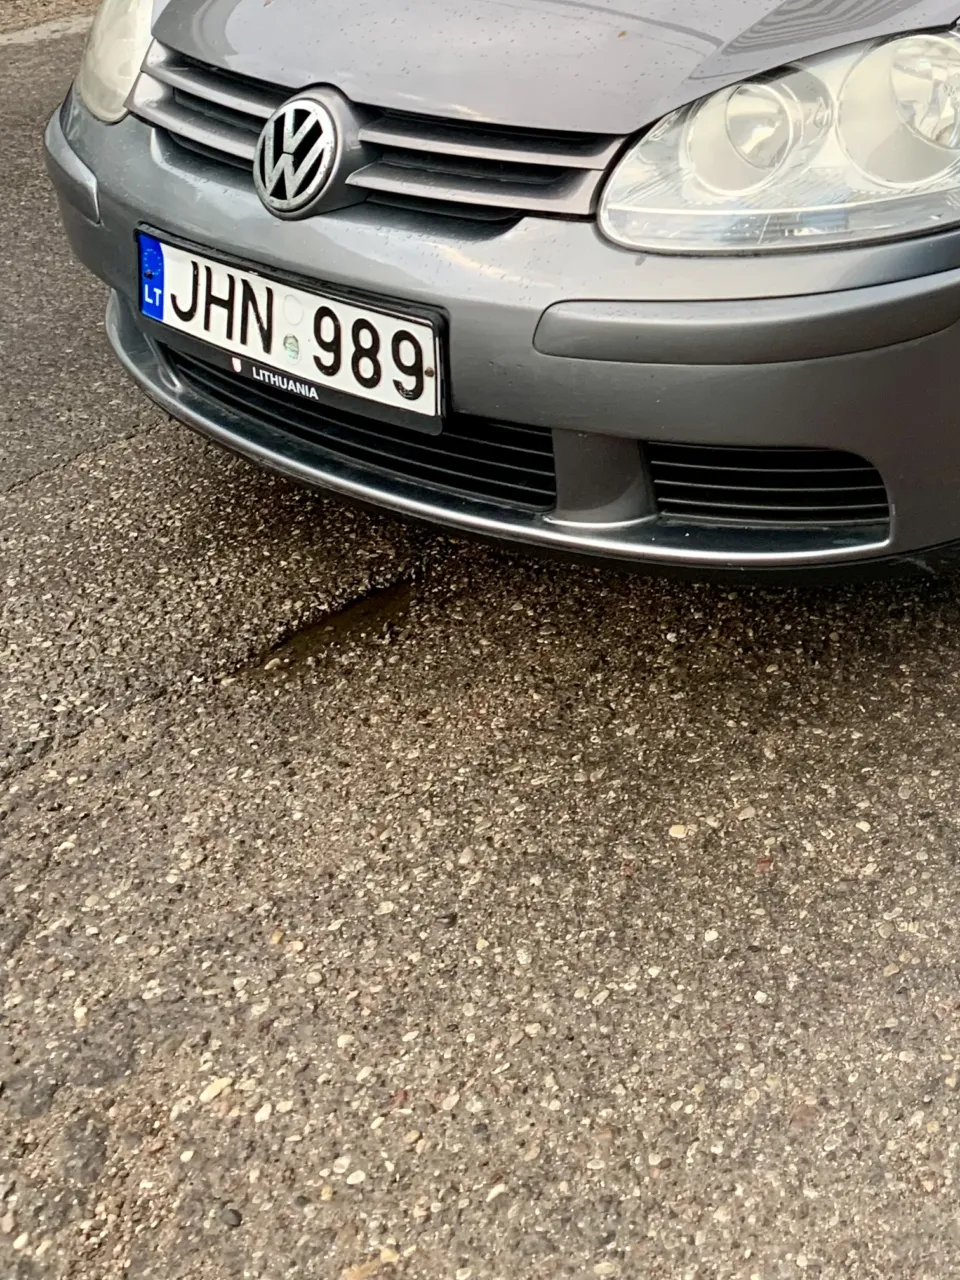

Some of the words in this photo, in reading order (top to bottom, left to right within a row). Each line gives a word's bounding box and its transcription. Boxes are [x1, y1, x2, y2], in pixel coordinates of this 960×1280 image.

[144, 283, 163, 307] LT
[170, 260, 274, 355] JHN
[313, 305, 425, 401] 989
[252, 366, 319, 401] LITHUANIA
